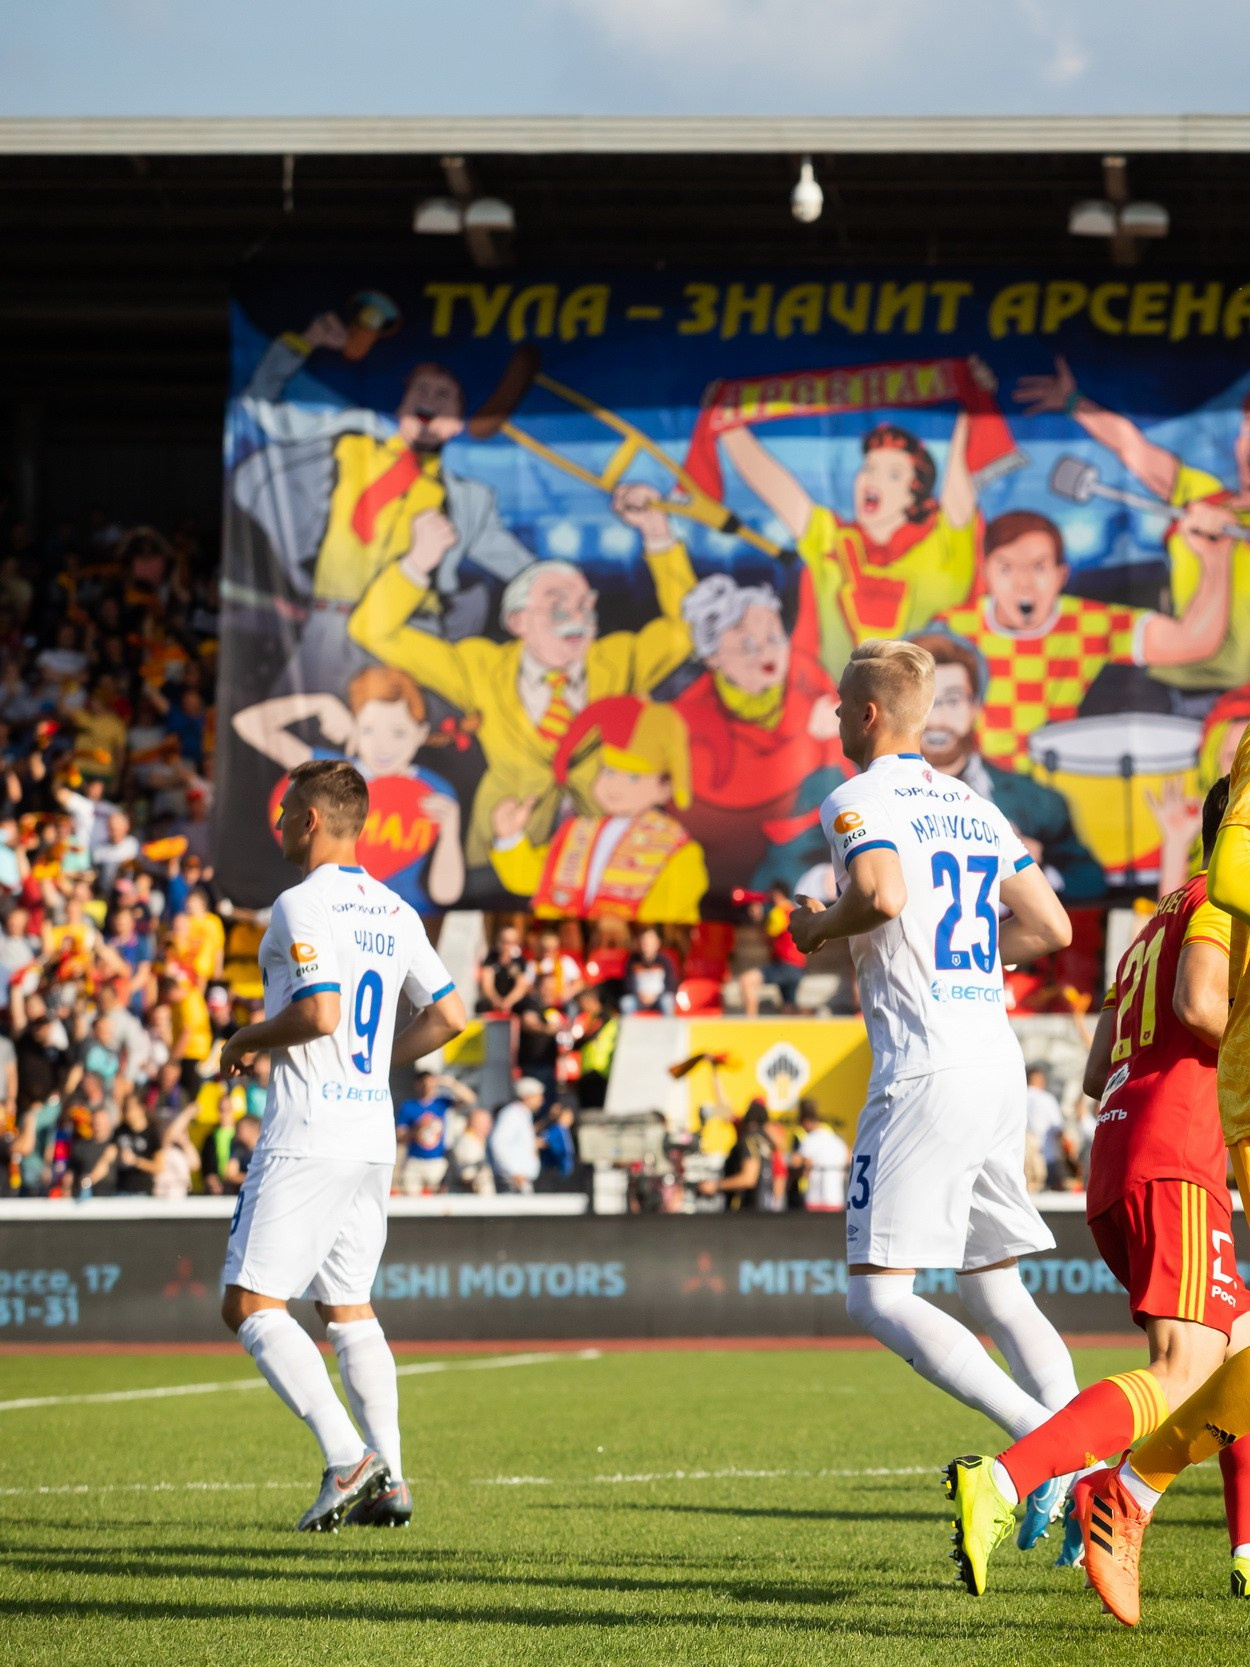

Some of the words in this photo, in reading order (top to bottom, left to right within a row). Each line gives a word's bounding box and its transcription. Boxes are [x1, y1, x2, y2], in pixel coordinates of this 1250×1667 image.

[424, 282, 612, 342] ТУЛА
[677, 281, 973, 341] ЗНАЧИТ
[930, 850, 999, 975] 23
[351, 968, 384, 1075] 9
[1111, 925, 1166, 1065] 21
[846, 1154, 872, 1211] 3
[84, 1263, 122, 1295] 17
[458, 1261, 629, 1299] MOTORS
